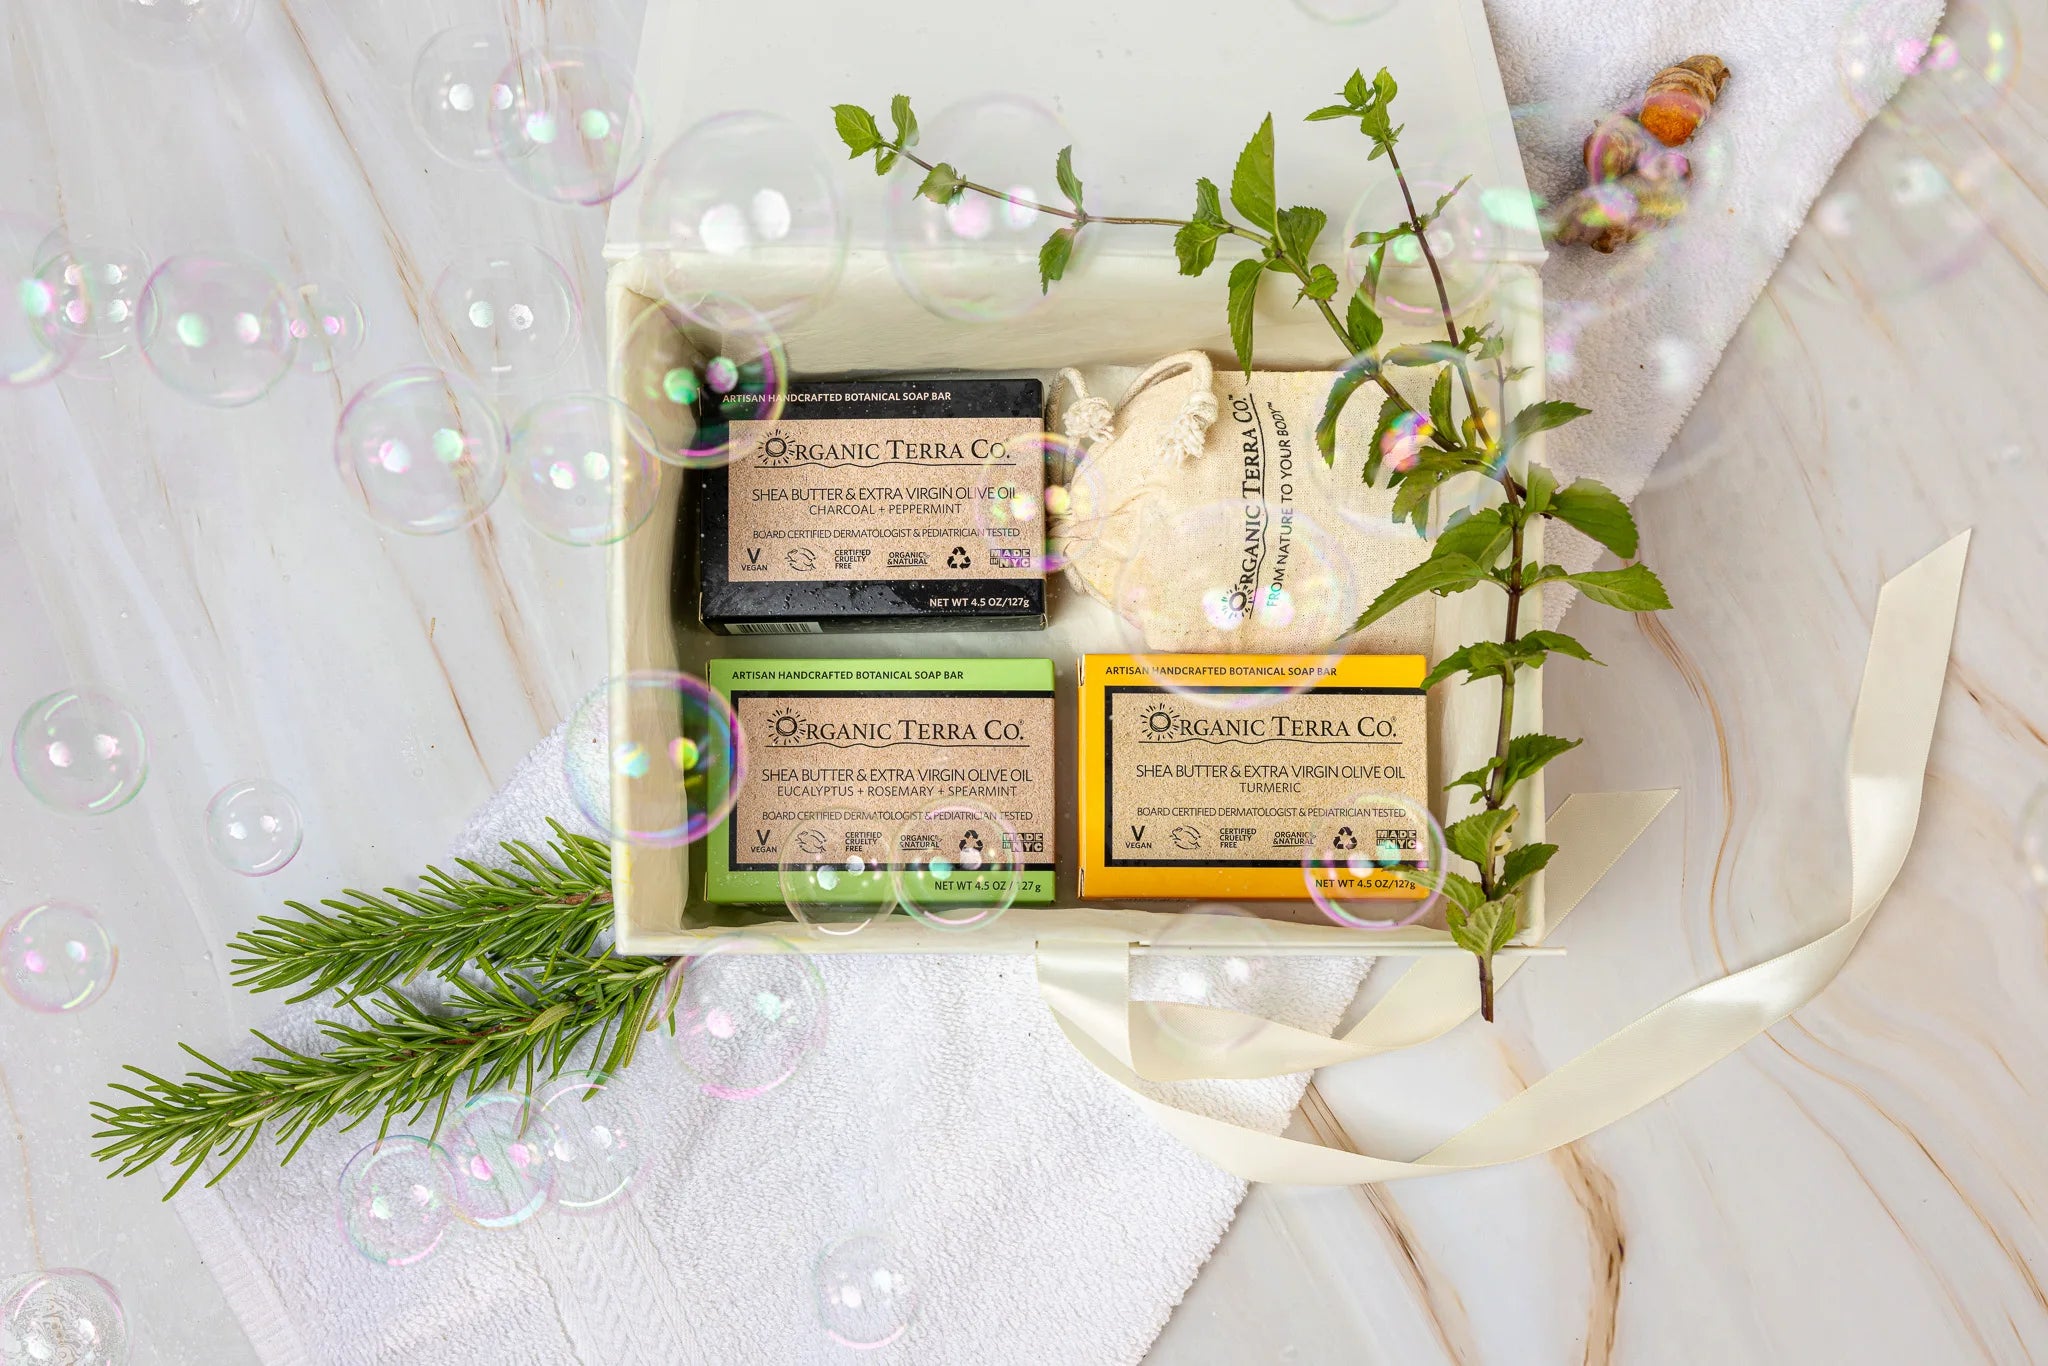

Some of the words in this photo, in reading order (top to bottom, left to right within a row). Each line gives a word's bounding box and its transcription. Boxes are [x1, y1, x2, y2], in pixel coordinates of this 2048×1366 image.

[723, 394, 766, 403] ARTISAN
[768, 393, 842, 402] HANDCRAFTED
[845, 392, 900, 402] BOTANICAL
[903, 392, 929, 401] SOAP
[931, 392, 951, 401] BAR
[887, 439, 964, 460] TERRA
[1241, 428, 1261, 499] TERRA
[1279, 440, 1293, 479] YOUR
[752, 489, 789, 502] SHEA
[791, 488, 843, 501] BUTTER
[846, 488, 857, 500] &
[859, 488, 903, 500] EXTRA
[907, 487, 953, 500] VIRGIN
[955, 487, 995, 500] OLIVE
[998, 487, 1017, 499] OIL
[1281, 484, 1293, 503] TO
[809, 505, 875, 515] CHARCOAL
[878, 506, 885, 514] +
[888, 504, 962, 515] PEPPERMINT
[753, 530, 785, 539] BOARD
[787, 530, 832, 539] CERTIFIED
[834, 529, 910, 538] DERMATOLOGIST
[913, 529, 921, 538] &
[923, 528, 985, 538] PEDIATRICIAN
[987, 528, 1020, 537] TESTED
[1276, 508, 1294, 565] NATURE
[990, 549, 1030, 557] MADE
[999, 558, 1030, 568] NYC
[1267, 567, 1286, 607] FROM
[930, 598, 948, 607] NET
[951, 598, 970, 607] WT
[971, 598, 986, 606] 4.5
[732, 671, 776, 680] ARTISAN
[778, 671, 853, 680] HANDCRAFTED
[856, 671, 912, 680] BOTANICAL
[915, 671, 941, 680] SOAP
[944, 671, 963, 680] BAR
[1106, 666, 1150, 675] ARTISAN
[1151, 667, 1227, 675] HANDCRAFTED
[1230, 667, 1286, 676] BOTANICAL
[1289, 667, 1315, 676] SOAP
[1317, 668, 1337, 676] BAR
[898, 720, 977, 740] TERRA
[1272, 716, 1350, 737] TERRA
[762, 769, 799, 782] SHEA
[802, 769, 853, 782] BUTTER
[857, 769, 868, 782] &
[871, 769, 914, 782] EXTRA
[917, 769, 966, 782] VIRGIN
[968, 769, 1008, 782] OLIVE
[1011, 769, 1032, 782] OIL
[1136, 764, 1173, 777] SHEA
[1176, 765, 1227, 778] BUTTER
[1231, 765, 1242, 778] &
[1244, 765, 1289, 778] EXTRA
[1292, 765, 1339, 778] VIRGIN
[1342, 765, 1381, 779] OLIVE
[1384, 765, 1405, 779] OIL
[777, 786, 854, 797] EUCALYPTUS
[868, 786, 934, 797] ROSEMARY
[948, 786, 1017, 796] SPEARMINT
[1240, 782, 1300, 793] TURMERIC
[762, 811, 795, 820] BOARD
[797, 811, 842, 820] CERTIFIED
[844, 811, 923, 820] DERMATOLOGIST
[925, 811, 932, 820] &
[933, 811, 997, 820] PEDIATRICIAN
[1000, 811, 1033, 820] TESTED
[1137, 807, 1170, 816] BOARD
[1172, 808, 1217, 817] CERTIFIED
[1218, 808, 1297, 817] DERMATOLOGIST
[1299, 808, 1306, 817] &
[1308, 808, 1370, 817] PEDIATRICIAN
[1372, 808, 1406, 818] TESTED
[901, 834, 935, 842] ORGANIC
[1003, 833, 1043, 841] MADE
[1274, 831, 1309, 839] ORGANIC
[1376, 830, 1417, 838] MADE
[1012, 841, 1043, 852] NYC
[1387, 839, 1417, 849] NYC
[935, 881, 953, 890] NET
[957, 881, 973, 890] WT
[975, 881, 989, 890] 4.5
[992, 881, 1006, 890] OZ
[1315, 879, 1333, 888] NET
[1338, 879, 1354, 888] WT
[1357, 879, 1373, 888] 4.5
